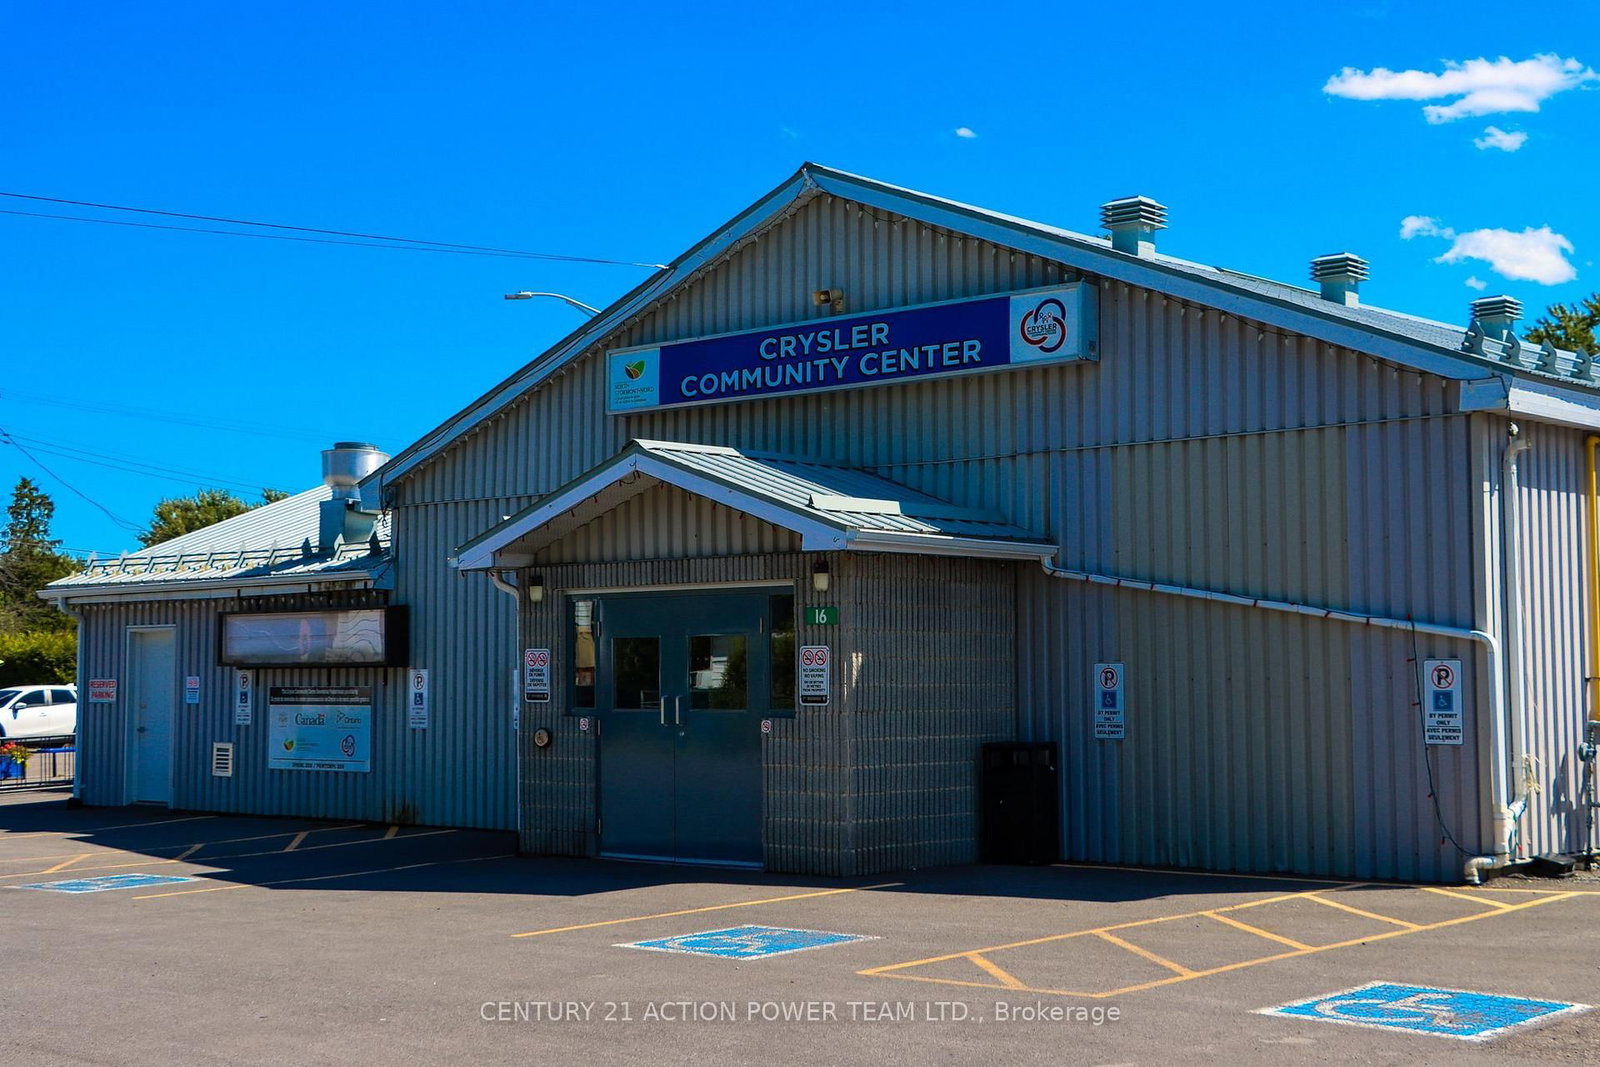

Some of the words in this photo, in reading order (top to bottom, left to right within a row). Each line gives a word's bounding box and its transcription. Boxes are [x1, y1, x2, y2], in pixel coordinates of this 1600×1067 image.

[1027, 323, 1057, 333] CRYSLER
[759, 322, 889, 361] CRYSLER
[679, 354, 850, 398] COMMUNITY
[858, 339, 982, 376] CENTER
[815, 609, 827, 624] 16
[90, 680, 116, 688] RESERVED
[91, 690, 114, 699] PARKING
[295, 713, 325, 726] Canada
